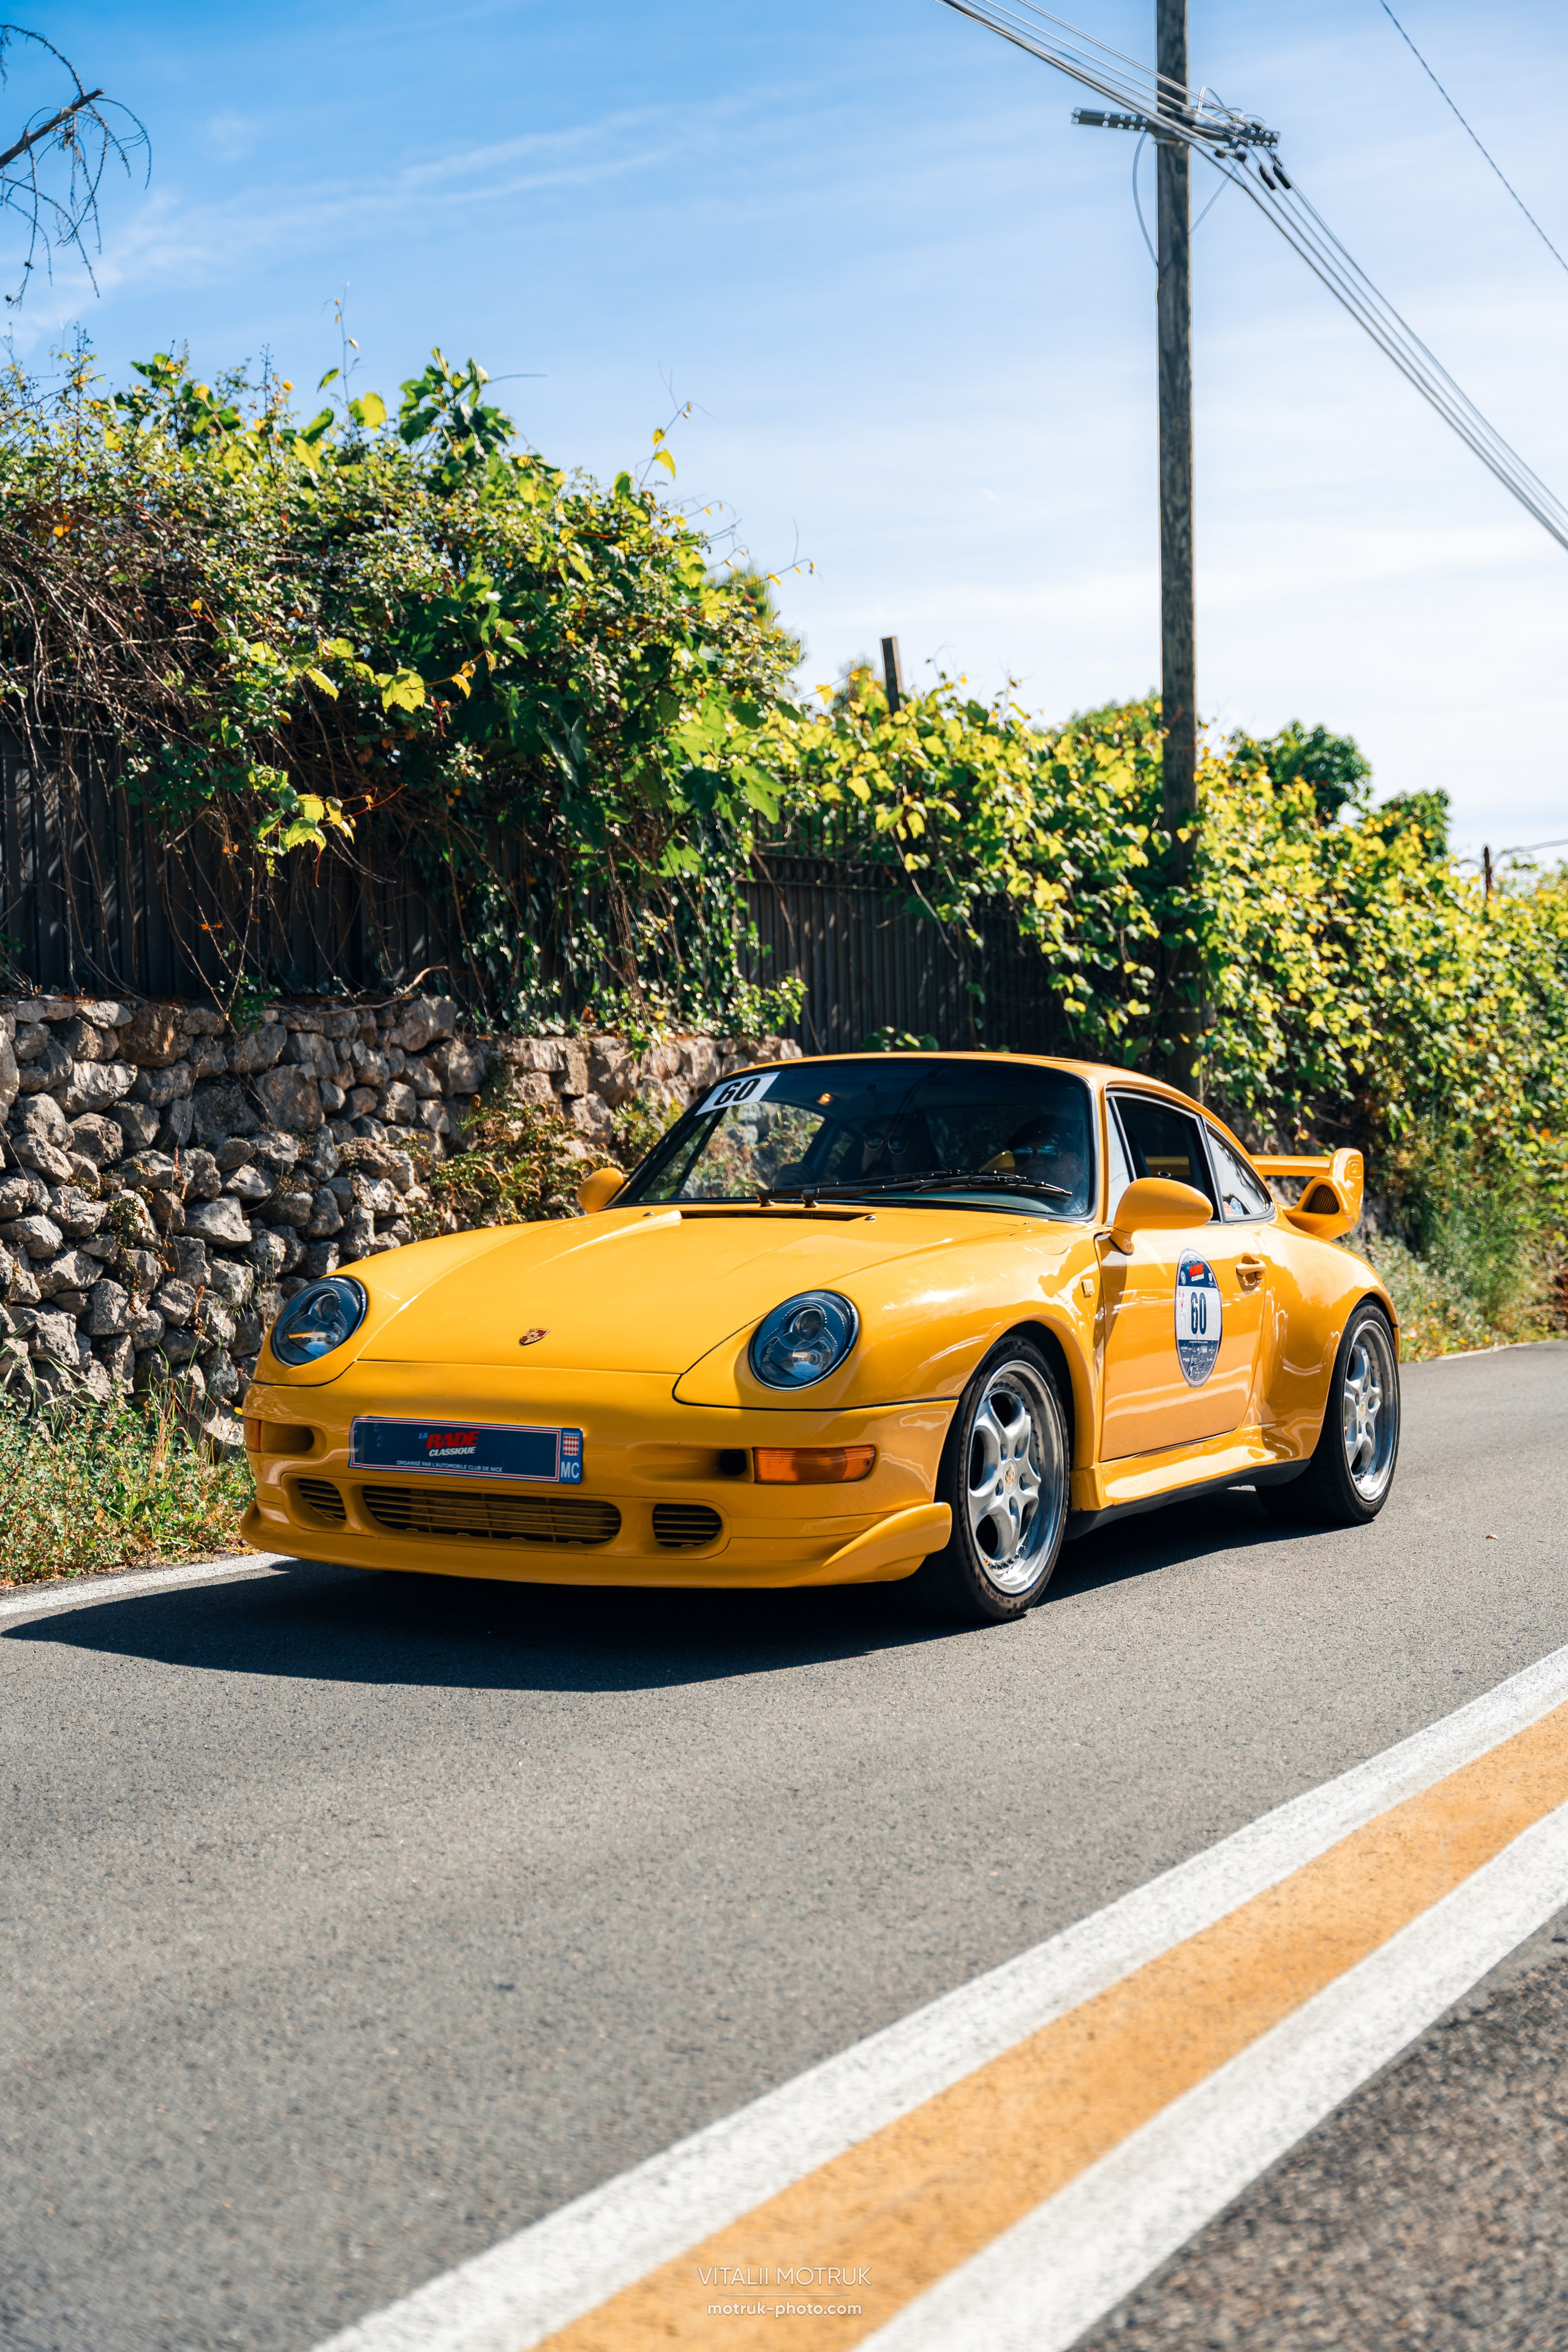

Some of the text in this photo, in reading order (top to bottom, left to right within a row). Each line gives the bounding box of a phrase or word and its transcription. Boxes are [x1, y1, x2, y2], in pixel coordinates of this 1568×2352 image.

[714, 1078, 761, 1106] 60
[1191, 1292, 1207, 1335] 60
[426, 1431, 481, 1449] RADE
[429, 1447, 477, 1457] CLASSIQUE
[560, 1461, 579, 1479] MC
